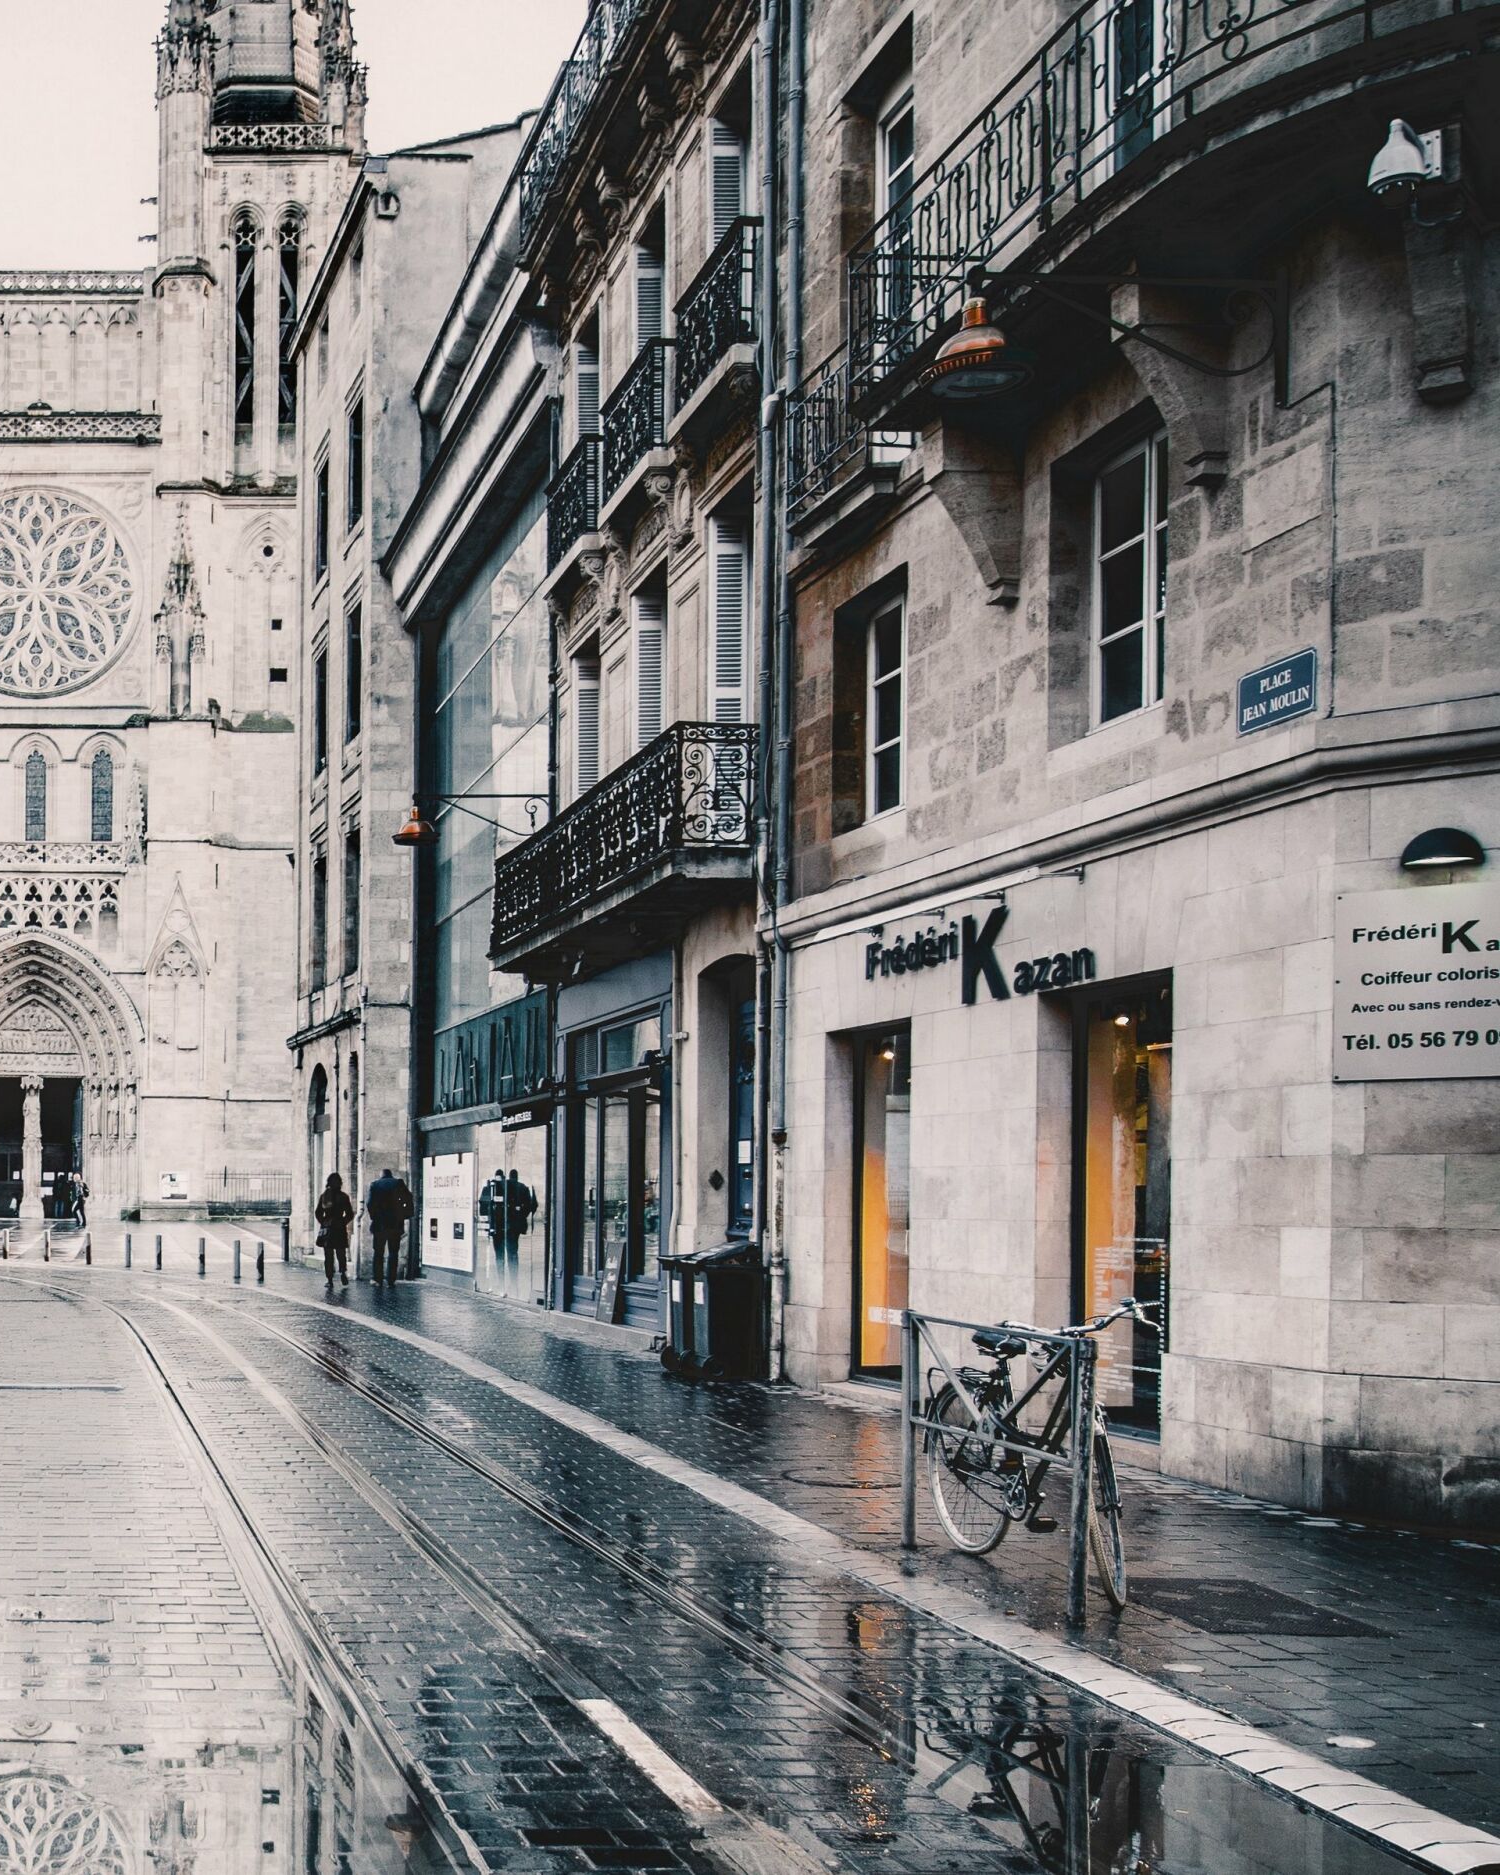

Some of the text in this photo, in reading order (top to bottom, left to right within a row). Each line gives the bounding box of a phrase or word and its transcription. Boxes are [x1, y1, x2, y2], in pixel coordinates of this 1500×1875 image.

[1260, 669, 1292, 693] PLACE
[1242, 685, 1310, 726] JEAN MOULIN
[1360, 966, 1500, 986] Coiffeur coloris
[1351, 1002, 1384, 1013] Avec
[1388, 1004, 1405, 1012] ou
[1408, 1001, 1441, 1011] sans
[1342, 1029, 1500, 1051] Tél. 05 56 79 0
